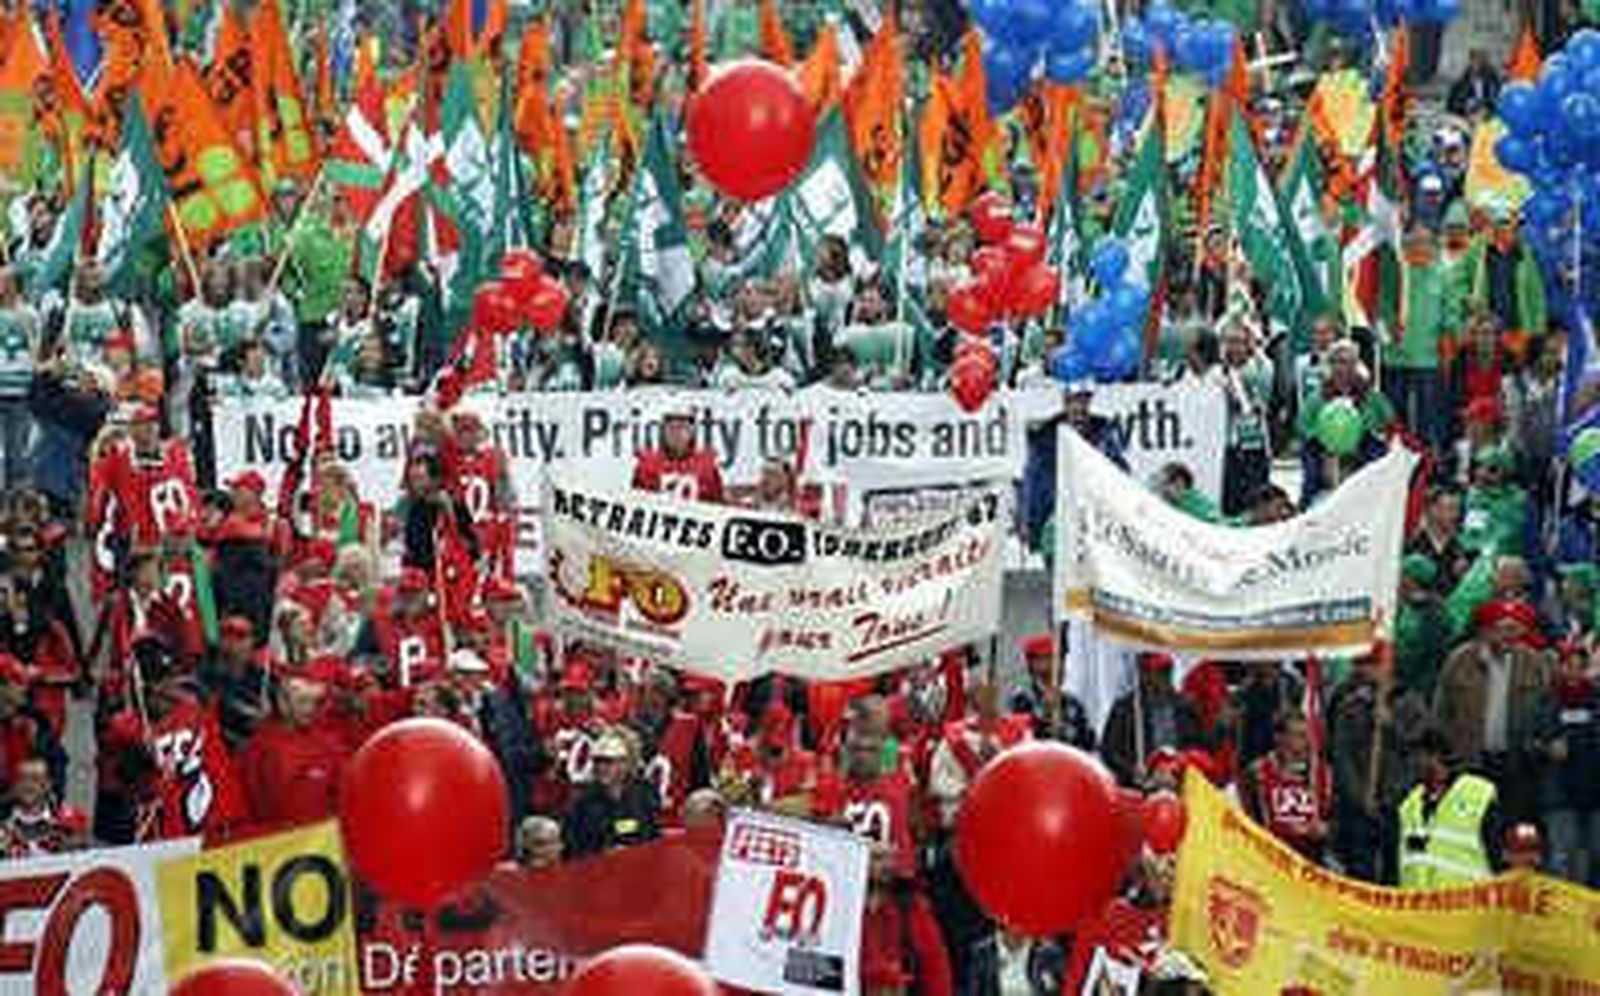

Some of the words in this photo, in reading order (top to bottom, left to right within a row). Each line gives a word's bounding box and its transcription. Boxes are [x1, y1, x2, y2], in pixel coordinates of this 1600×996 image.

[829, 406, 916, 466] jobs
[932, 406, 1007, 456] and
[196, 854, 346, 955] NO
